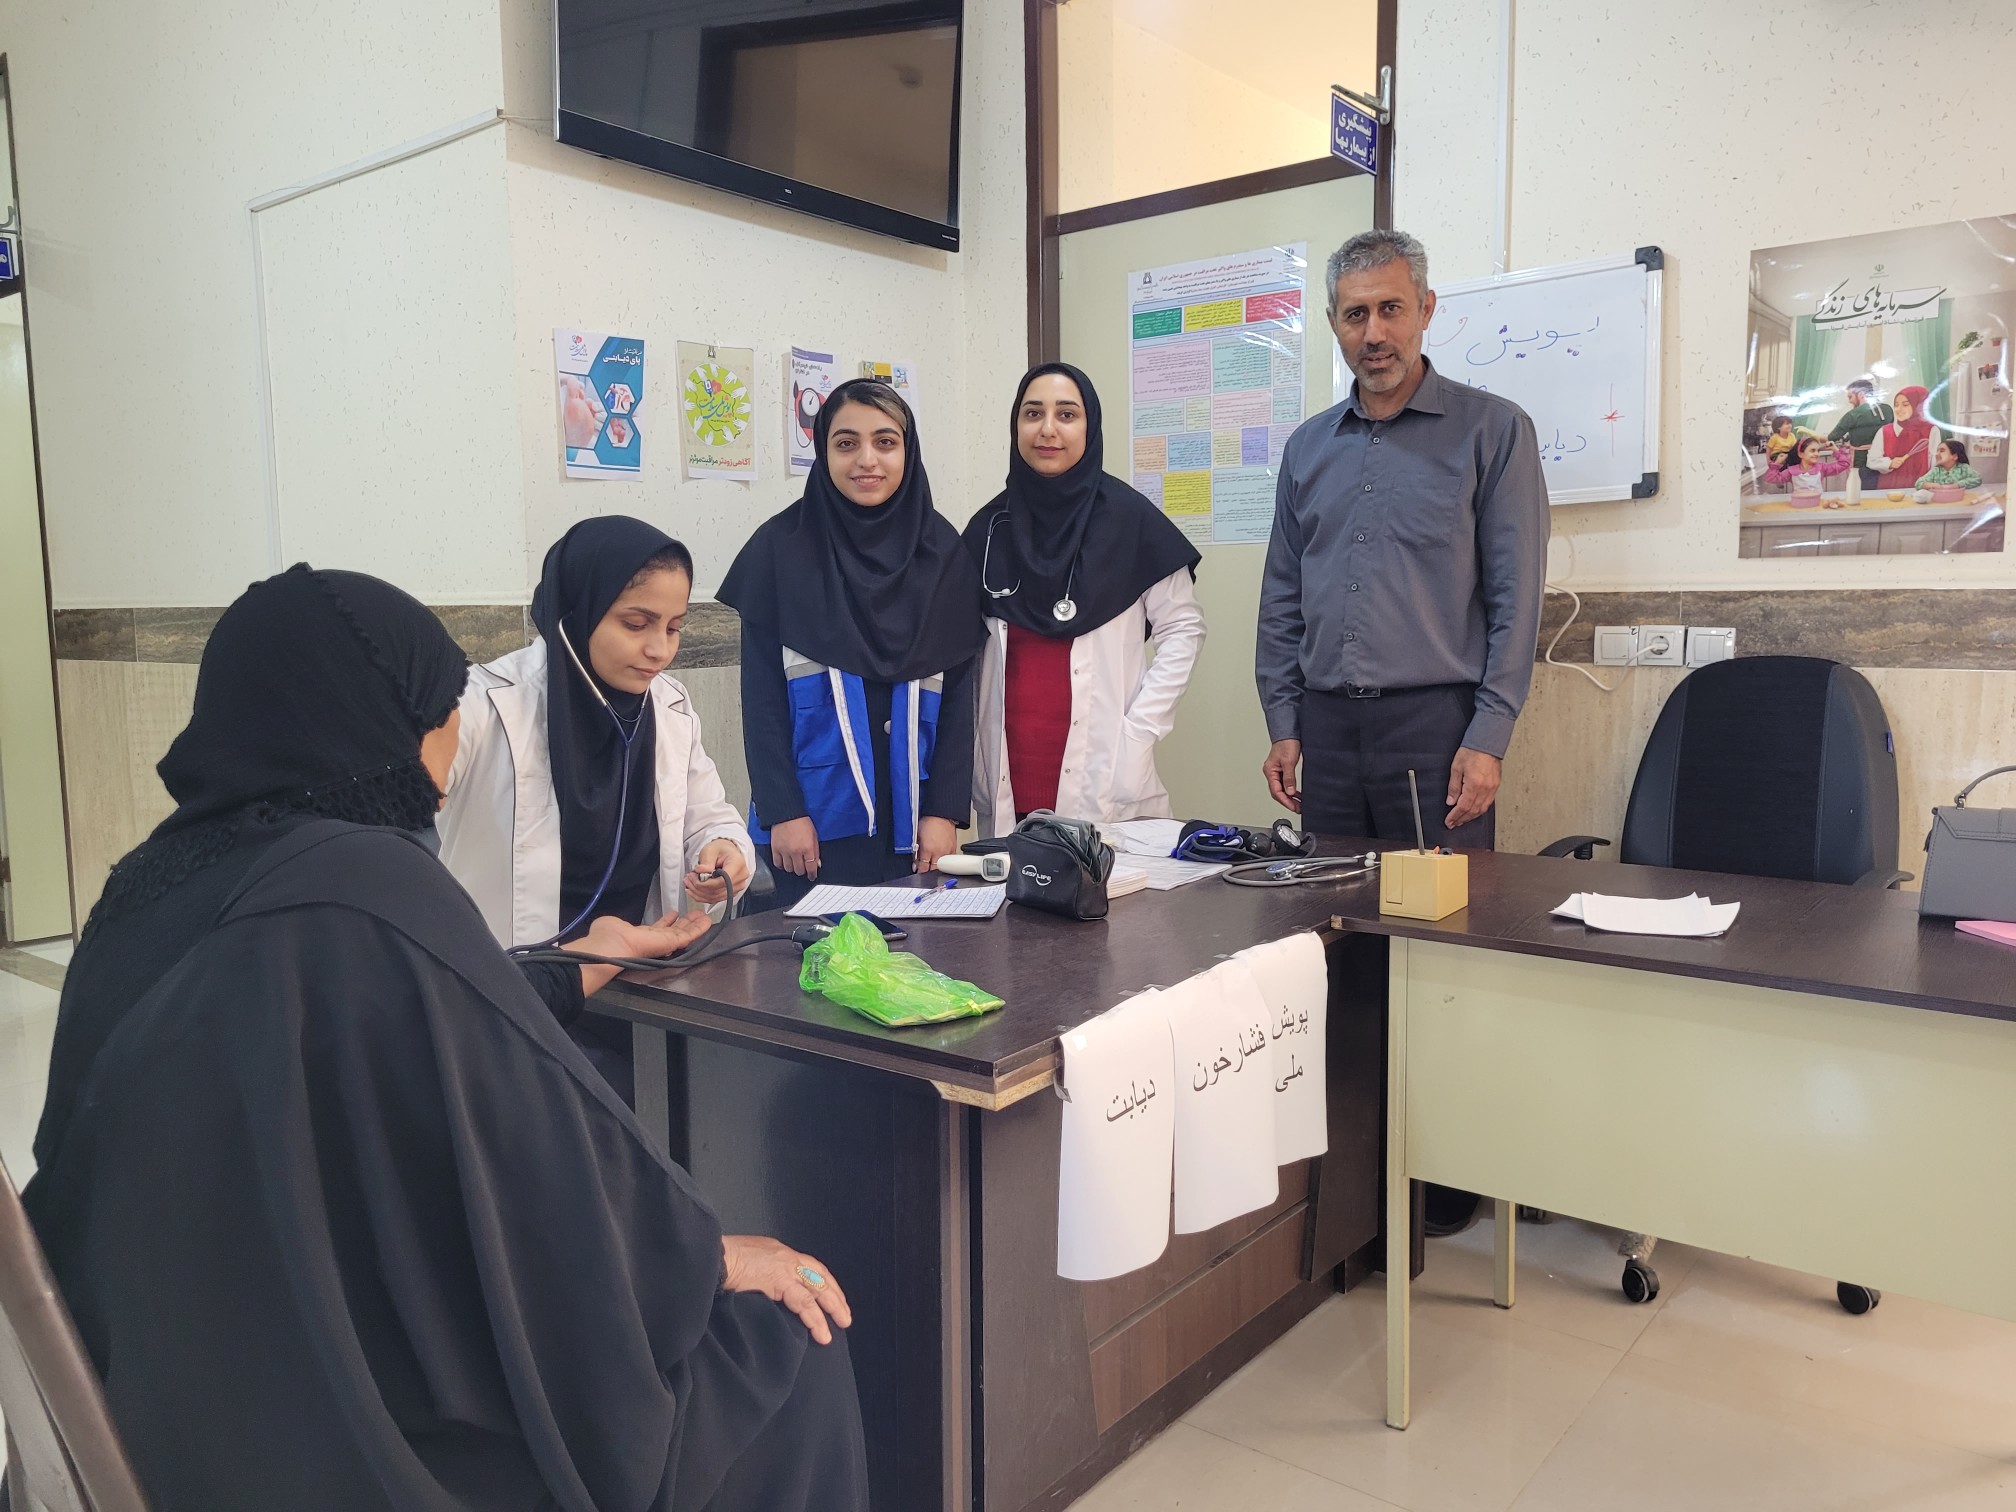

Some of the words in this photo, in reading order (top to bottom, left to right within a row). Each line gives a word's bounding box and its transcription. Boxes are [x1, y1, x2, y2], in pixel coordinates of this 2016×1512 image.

[1338, 112, 1372, 143] پیشگیری
[1367, 146, 1376, 166] از
[602, 353, 630, 364] دیابتی
[629, 355, 641, 366] پای
[1539, 428, 1587, 462] دیاب
[1271, 1004, 1309, 1040] پویش
[1275, 1053, 1304, 1093] ملی
[1106, 1078, 1156, 1122] دیابت
